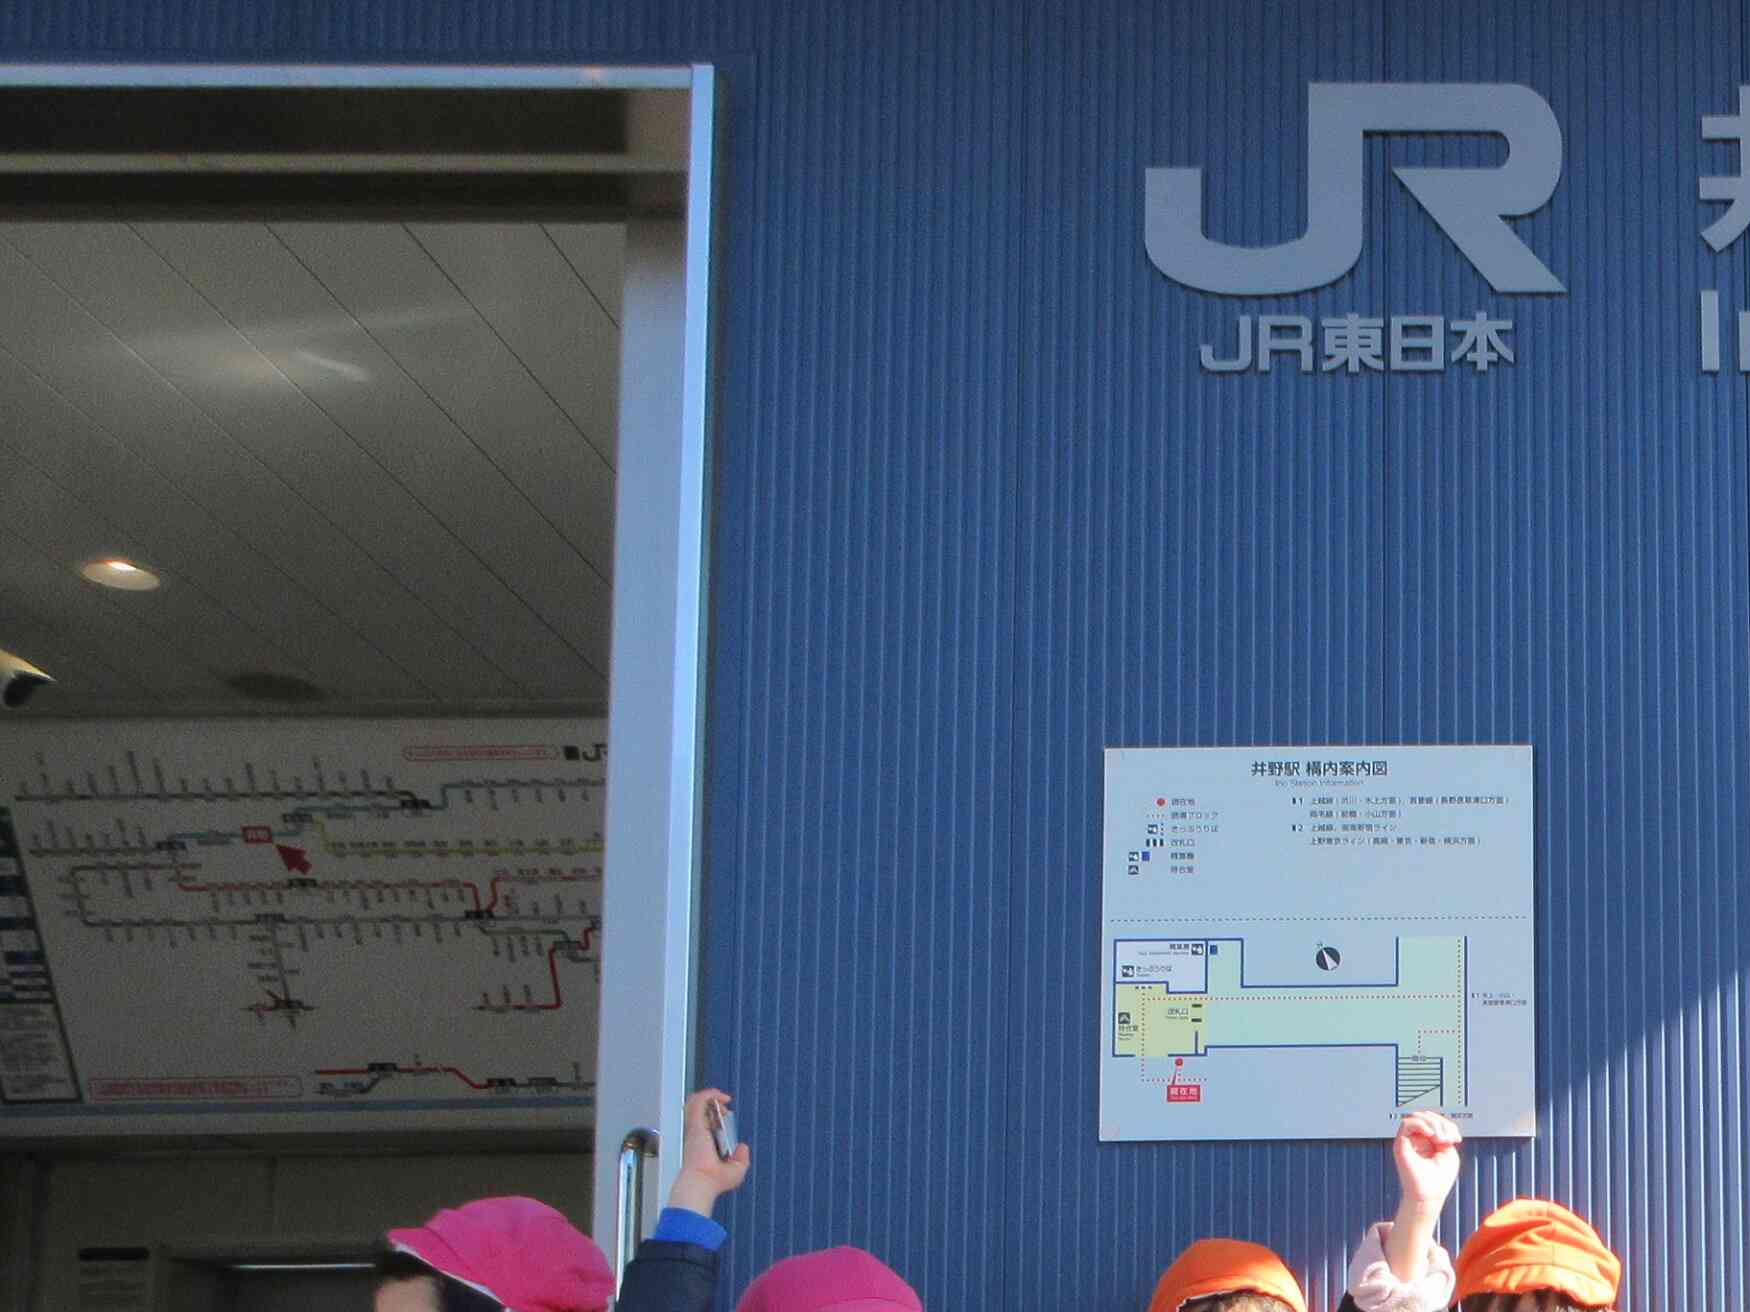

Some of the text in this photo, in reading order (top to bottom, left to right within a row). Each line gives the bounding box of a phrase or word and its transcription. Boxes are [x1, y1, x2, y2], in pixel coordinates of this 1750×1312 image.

[1144, 82, 1567, 297] JR
[1199, 314, 1515, 374] JR東日本
[1251, 759, 1388, 777] 井野駅 構内案内図
